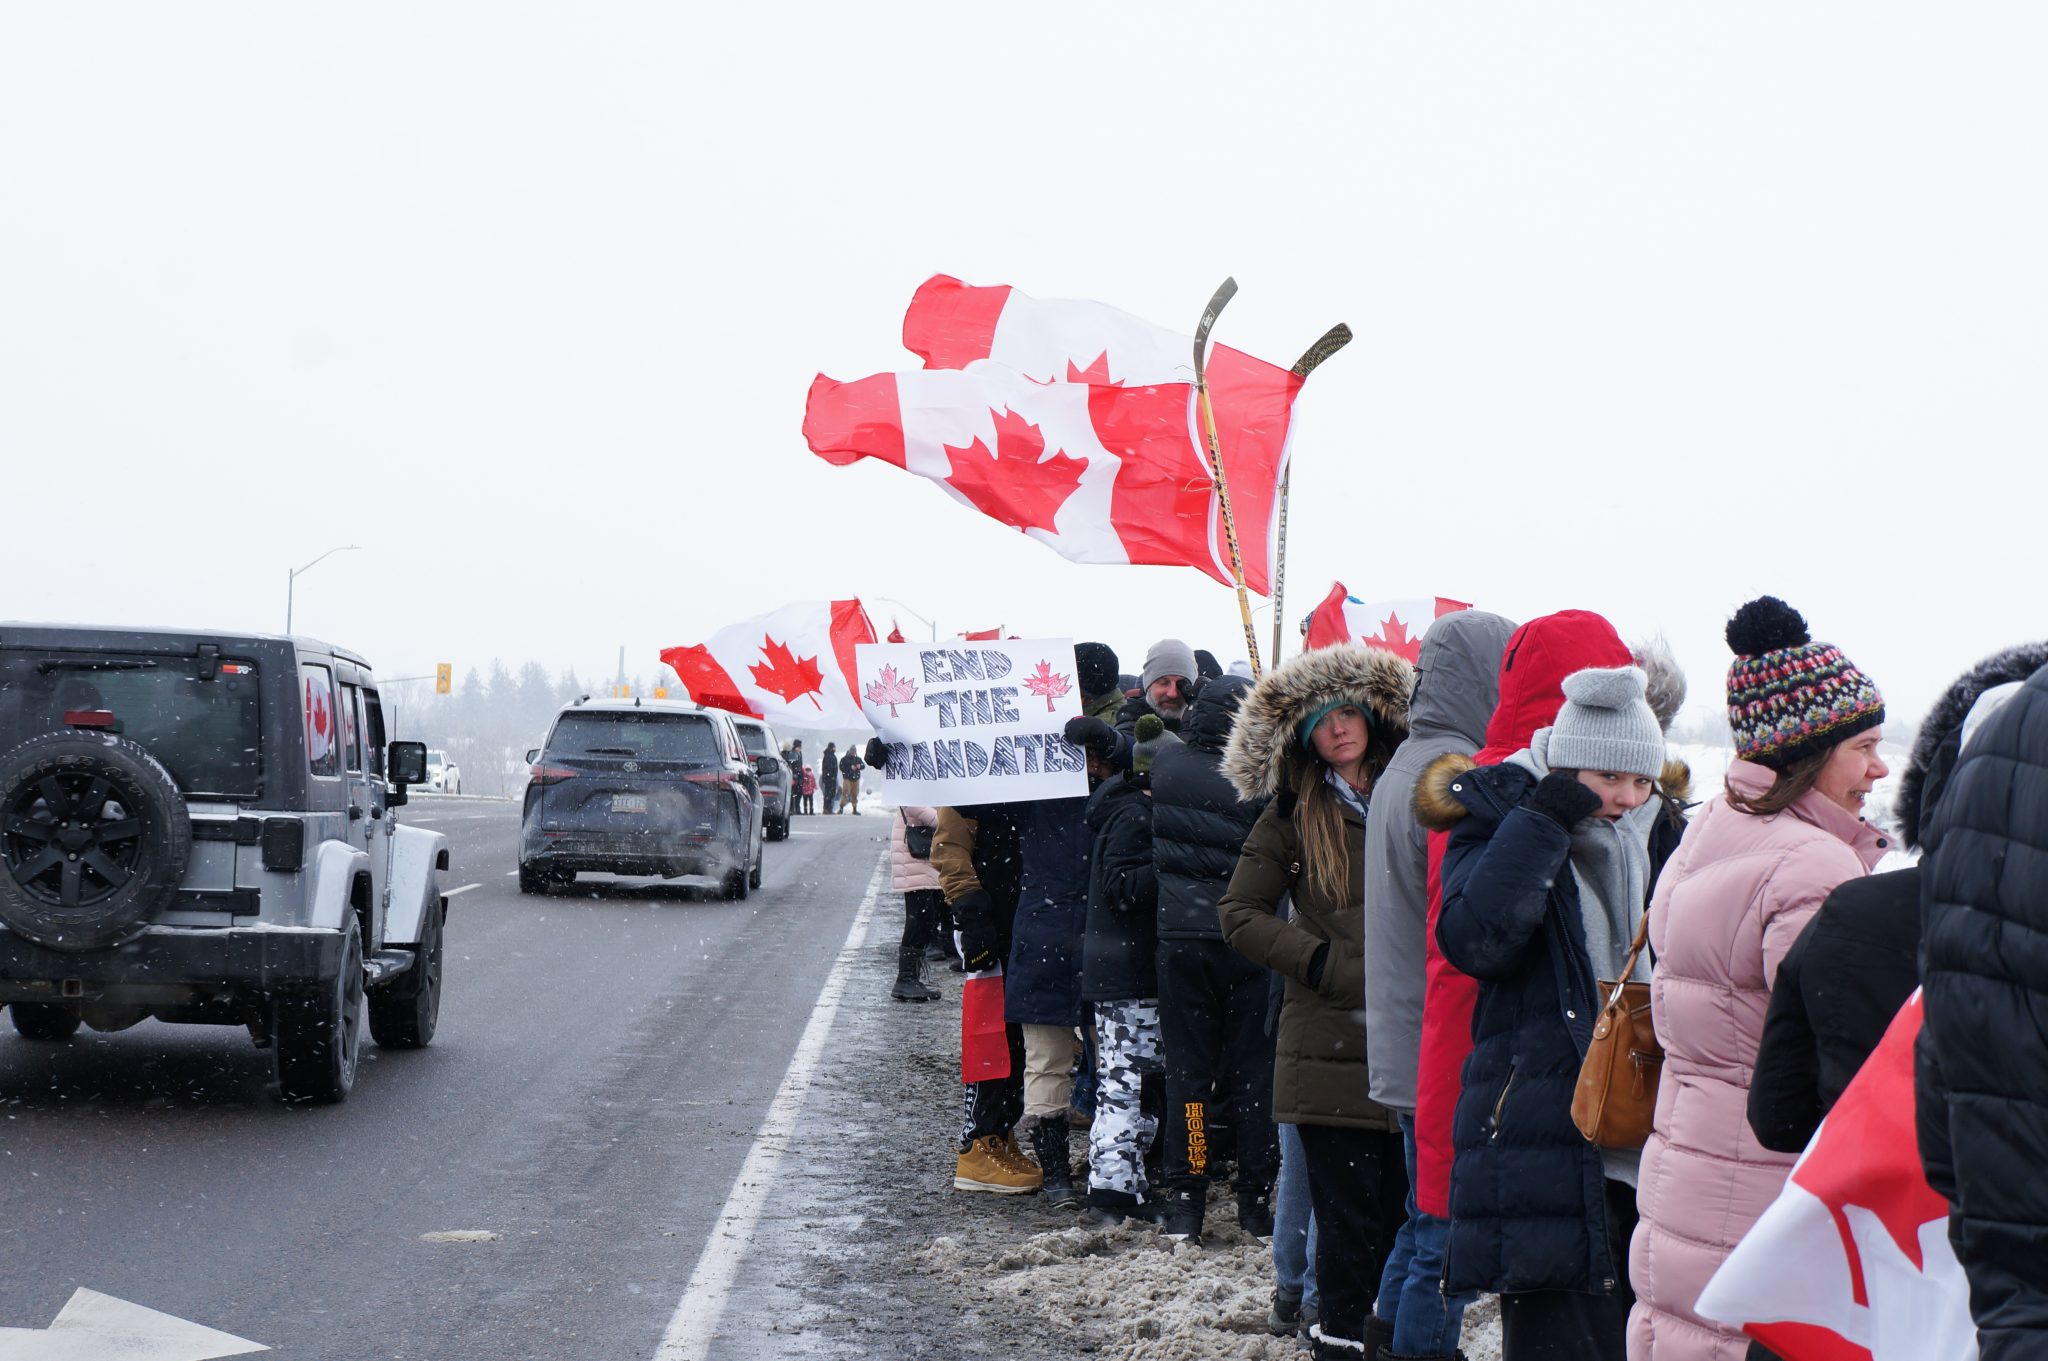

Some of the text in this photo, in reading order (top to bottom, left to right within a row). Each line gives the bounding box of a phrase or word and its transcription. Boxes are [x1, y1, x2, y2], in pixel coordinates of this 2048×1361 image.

[920, 649, 1012, 683] END
[924, 686, 1020, 728] THE
[884, 733, 1085, 780] MANDATES
